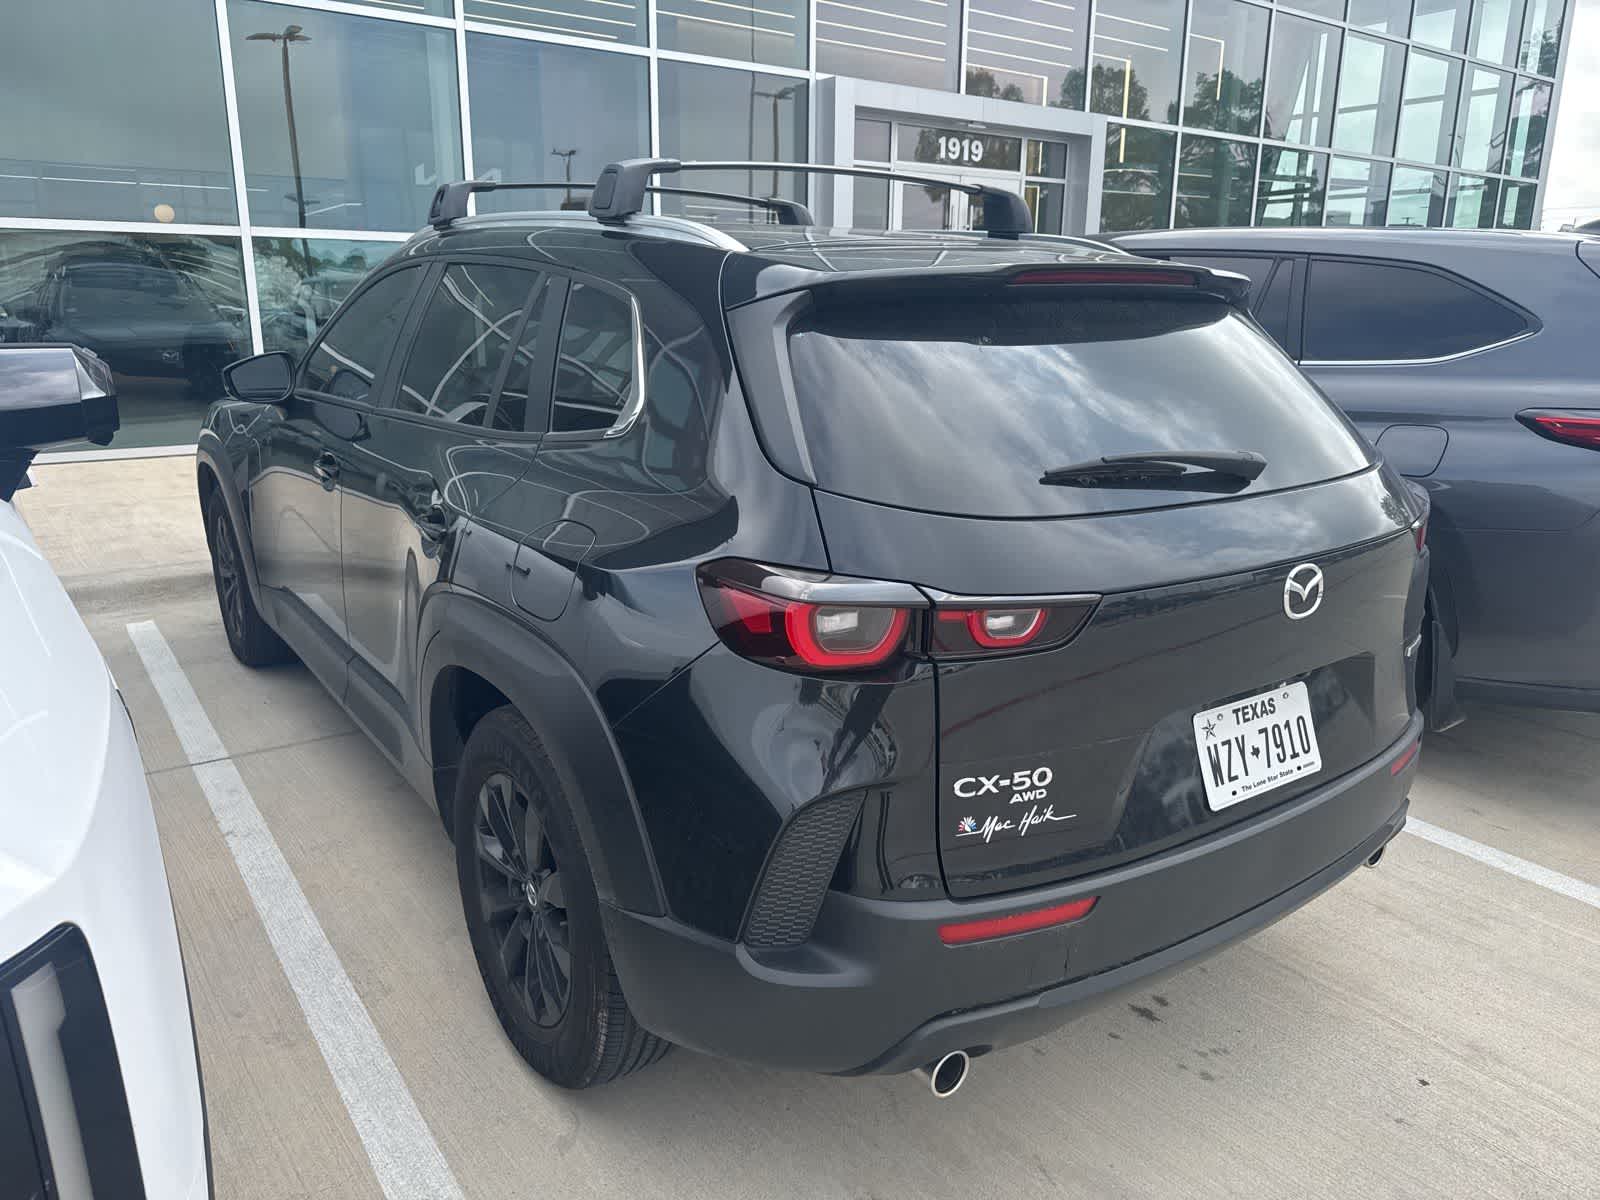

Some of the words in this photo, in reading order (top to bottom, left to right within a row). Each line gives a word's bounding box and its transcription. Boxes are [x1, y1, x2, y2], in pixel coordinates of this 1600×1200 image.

[938, 136, 983, 162] 1919
[1232, 697, 1276, 725] TEXAS
[1207, 734, 1249, 788] WZY
[1258, 715, 1311, 768] 7910
[953, 766, 1053, 798] CX-50
[1253, 779, 1266, 788] Lone
[1267, 774, 1278, 783] Star
[1280, 769, 1293, 778] State
[1009, 788, 1047, 804] AWD
[955, 815, 1016, 843] Mac
[1018, 804, 1077, 836] Haik
